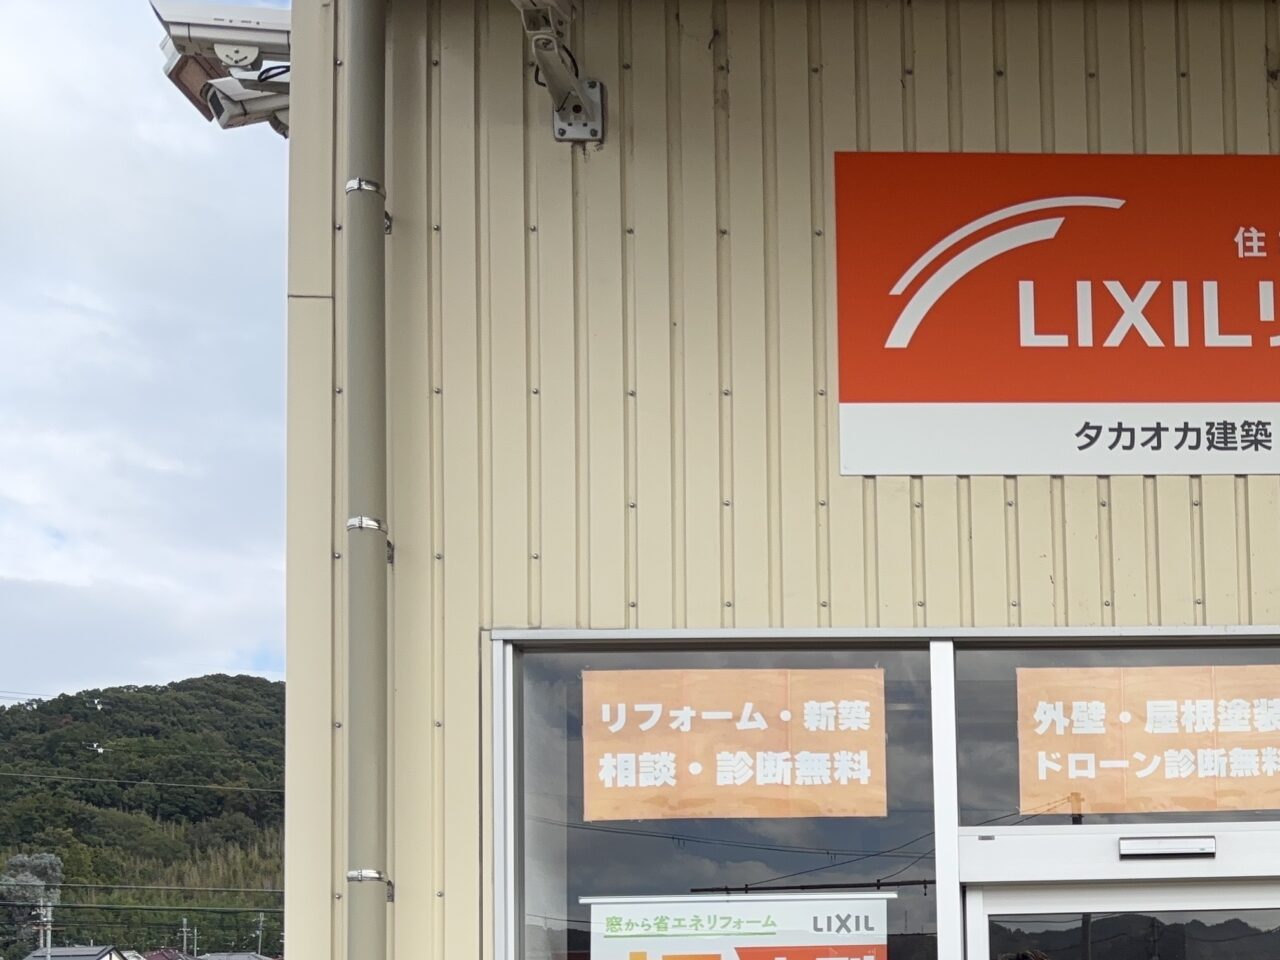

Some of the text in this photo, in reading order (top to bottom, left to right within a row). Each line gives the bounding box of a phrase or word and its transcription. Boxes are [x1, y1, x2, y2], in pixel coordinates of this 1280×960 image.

[1073, 420, 1273, 453] タカオカ建築
[600, 700, 871, 733] リフォーム・新築
[599, 750, 872, 787] 相談・診断無料
[605, 914, 874, 934] 窓から省エネリフォーム LIXIL
